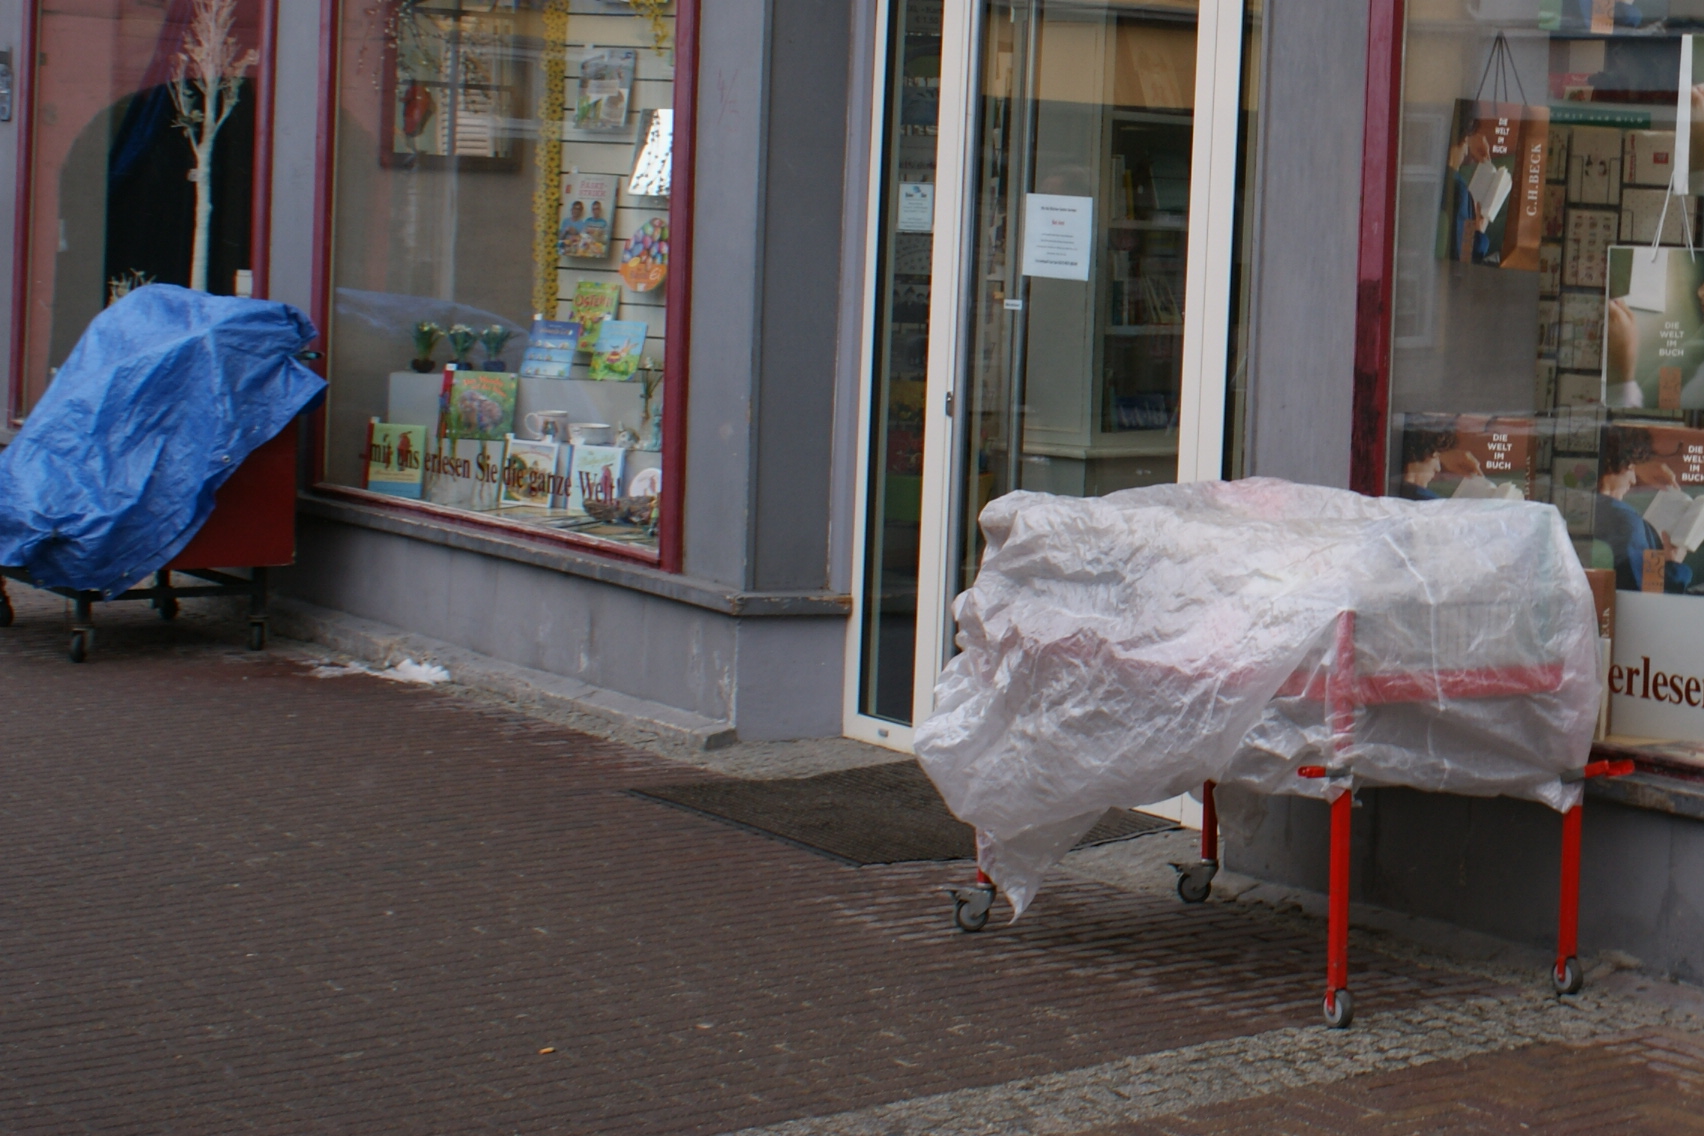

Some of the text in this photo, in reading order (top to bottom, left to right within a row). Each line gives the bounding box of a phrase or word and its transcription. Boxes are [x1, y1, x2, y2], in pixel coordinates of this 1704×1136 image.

[1498, 117, 1509, 126] DIE
[1495, 127, 1510, 136] WELT
[1497, 136, 1505, 144] IM
[1492, 145, 1508, 154] BUCH
[1526, 143, 1543, 217] C.H.BECK
[1664, 321, 1680, 330] DIE
[1659, 330, 1685, 339] WELT
[1666, 339, 1677, 347] IM
[1658, 348, 1685, 357] BUCH
[1492, 433, 1508, 442] DIE
[1487, 442, 1513, 452] WELT
[1688, 445, 1704, 454] DIE
[1494, 451, 1505, 460] IM
[1486, 460, 1512, 470] BUCH
[1689, 464, 1700, 472] IM
[424, 446, 471, 480] erlesen
[475, 451, 499, 484] Sie
[502, 458, 525, 489] die
[528, 468, 572, 498] ganze
